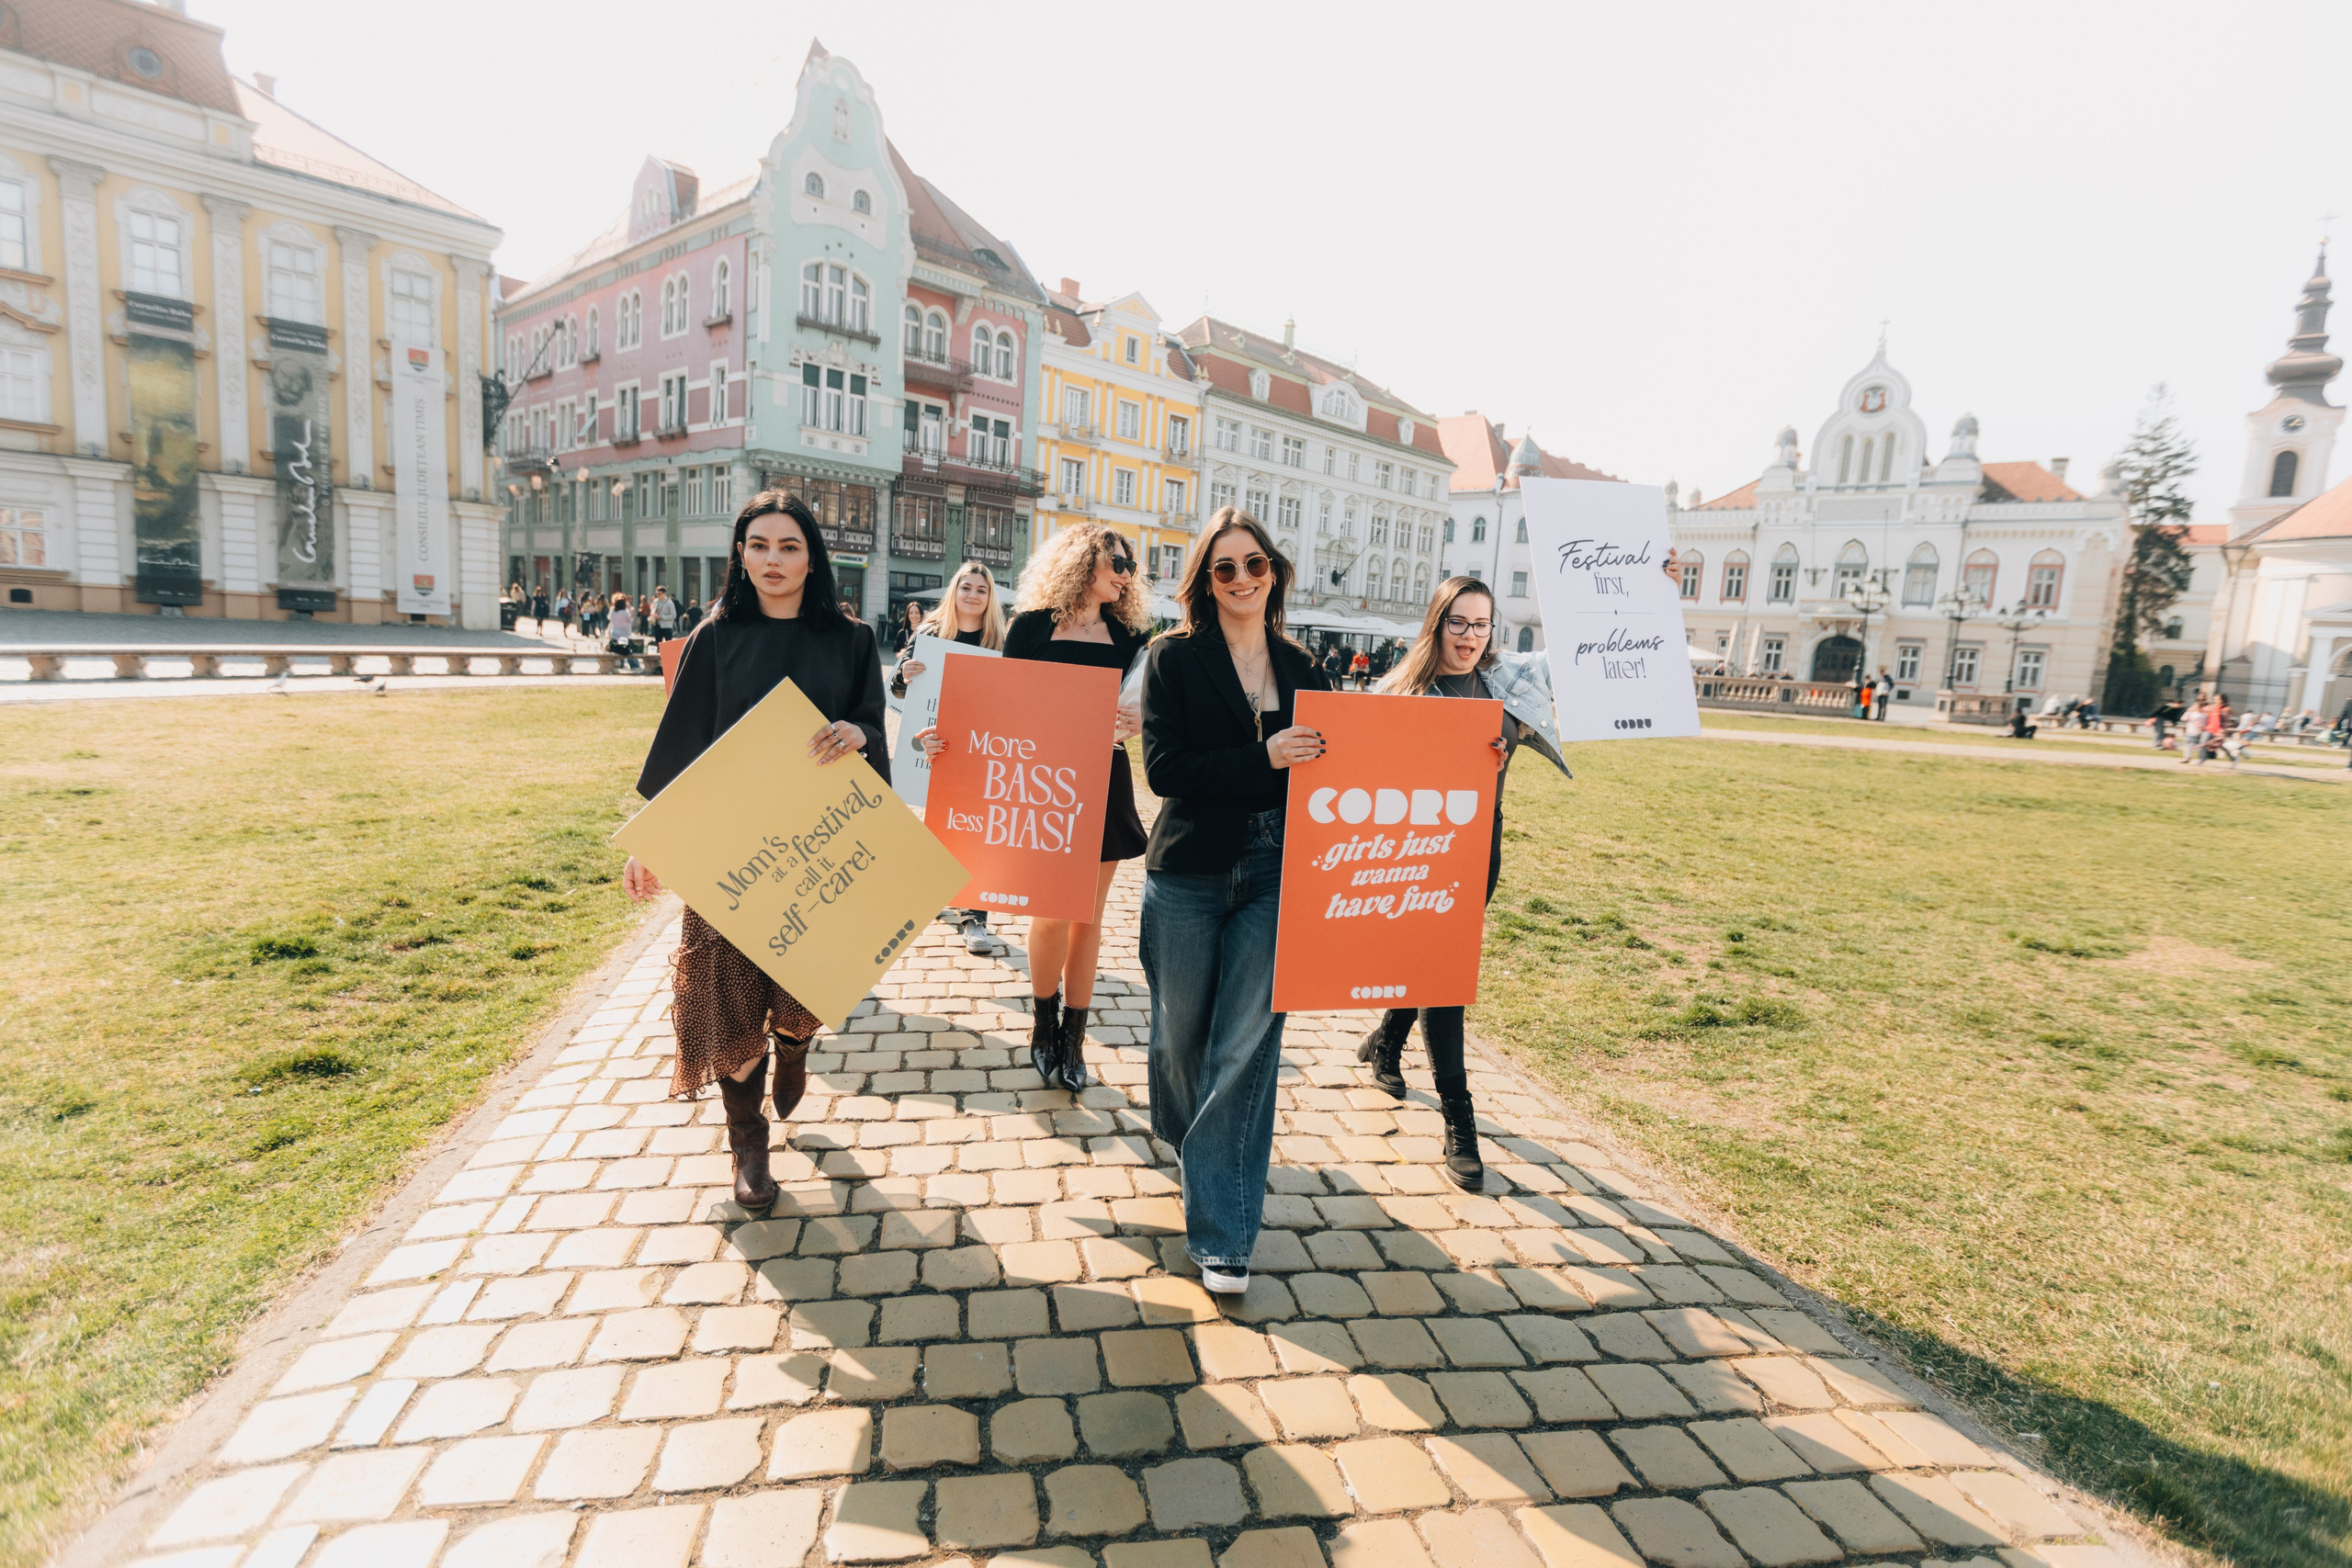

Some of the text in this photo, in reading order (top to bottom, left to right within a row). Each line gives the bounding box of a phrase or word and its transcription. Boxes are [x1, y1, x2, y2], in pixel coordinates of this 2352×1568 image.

[271, 334, 307, 345] Corneliu
[307, 339, 327, 349] Baba
[319, 397, 327, 439] APROAPE
[321, 443, 328, 455] DE
[322, 457, 330, 496] PRIVIRE
[418, 499, 429, 562] CONSILIUL
[1558, 540, 1651, 575] Festival
[1594, 571, 1629, 598] first,
[1575, 628, 1664, 666] problems
[1602, 657, 1646, 679] later!
[1614, 718, 1652, 729] CODRU
[968, 730, 1036, 760] More
[984, 760, 1083, 816] BASS,
[1308, 787, 1478, 825] CODRU
[771, 779, 883, 883] at a festival
[947, 805, 1075, 854] less BIAS!
[1321, 830, 1455, 871] girls just
[717, 835, 791, 911] Mom's
[795, 855, 836, 897] call it
[1351, 864, 1430, 886] wanna
[980, 892, 1029, 906] CODRU
[1325, 886, 1454, 919] have fun
[875, 919, 915, 965] CODRU
[1351, 986, 1407, 998] CODRU
